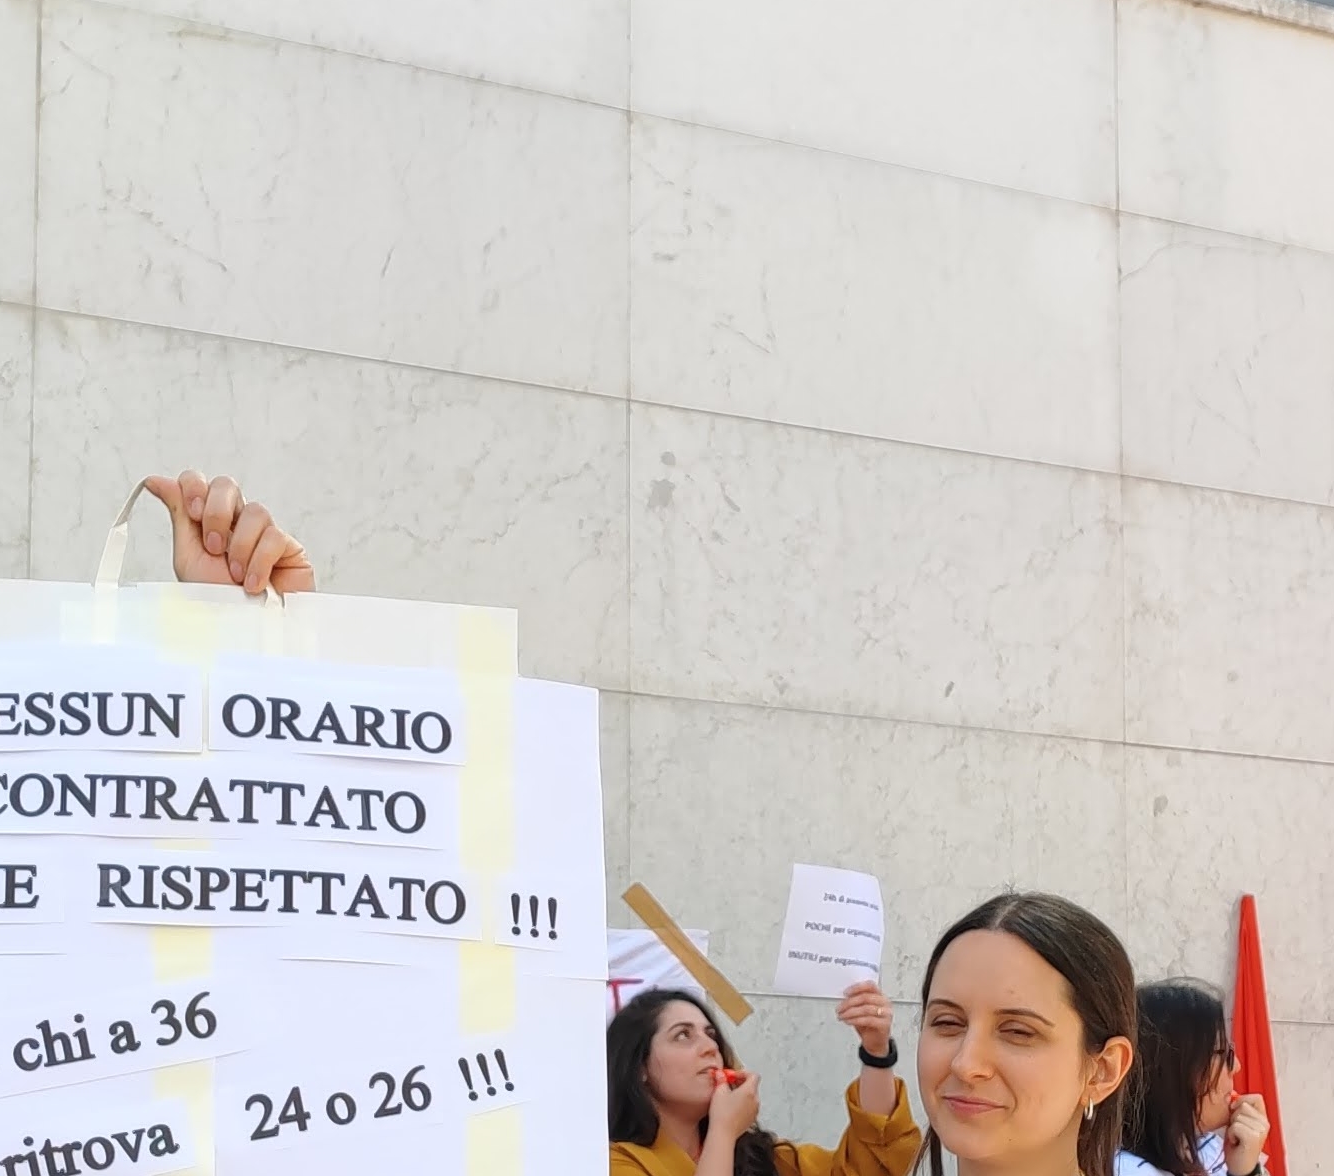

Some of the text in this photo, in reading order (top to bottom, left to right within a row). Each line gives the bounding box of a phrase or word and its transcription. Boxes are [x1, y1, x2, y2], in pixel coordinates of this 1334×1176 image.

[223, 694, 451, 753] ORARIO
[97, 864, 465, 924] RISPETTATO
[511, 894, 556, 939] !!!
[14, 1014, 95, 1071] chi
[109, 1021, 141, 1053] a
[151, 992, 216, 1045] 36
[246, 1087, 310, 1140] 24
[326, 1093, 356, 1125] o
[369, 1066, 431, 1118] 26
[459, 1049, 514, 1100] !!!
